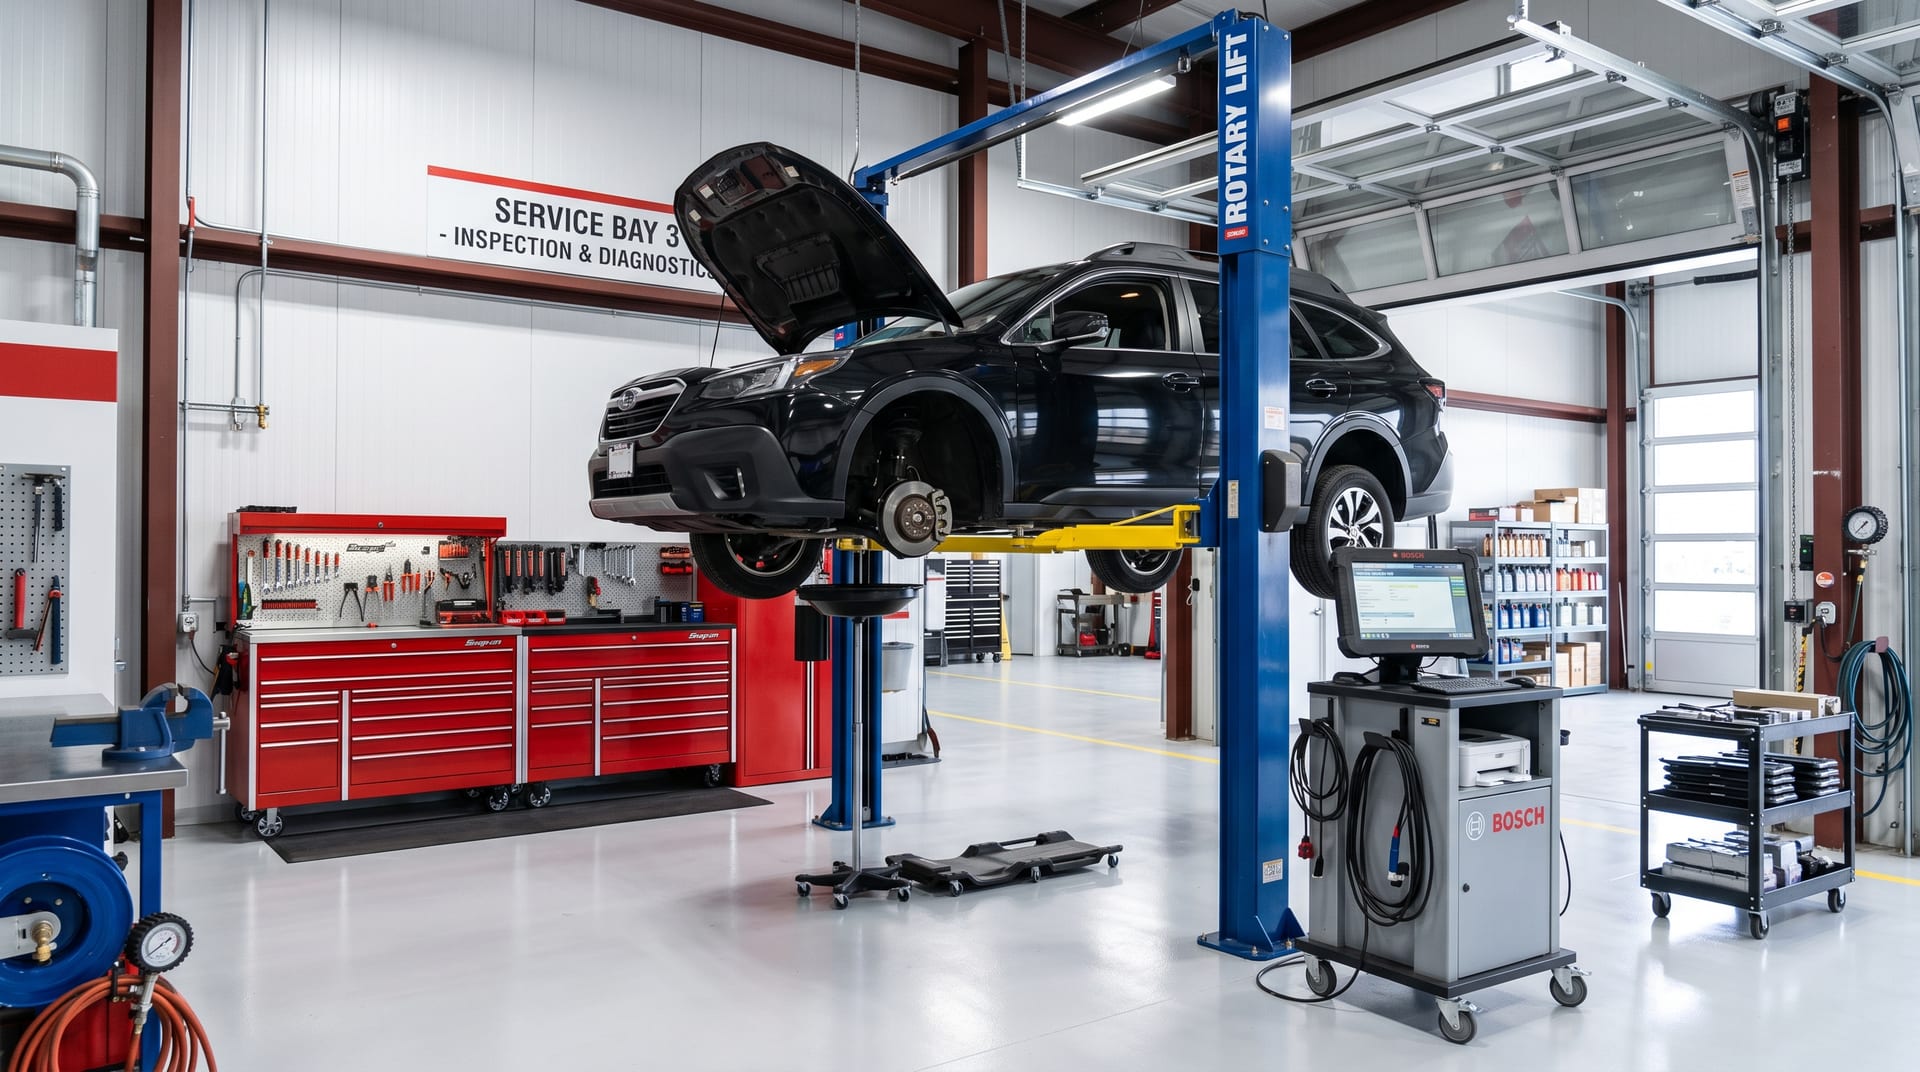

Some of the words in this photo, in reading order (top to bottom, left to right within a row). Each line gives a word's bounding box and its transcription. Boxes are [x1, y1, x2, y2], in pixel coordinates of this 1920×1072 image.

[1225, 33, 1248, 96] LIFT
[1225, 105, 1248, 225] ROTARY
[453, 226, 573, 260] INSPECTION
[579, 244, 593, 264] &
[495, 197, 604, 237] SERVICE
[613, 215, 659, 245] BAY
[666, 223, 680, 248] 3
[1492, 806, 1545, 833] BOSCH
